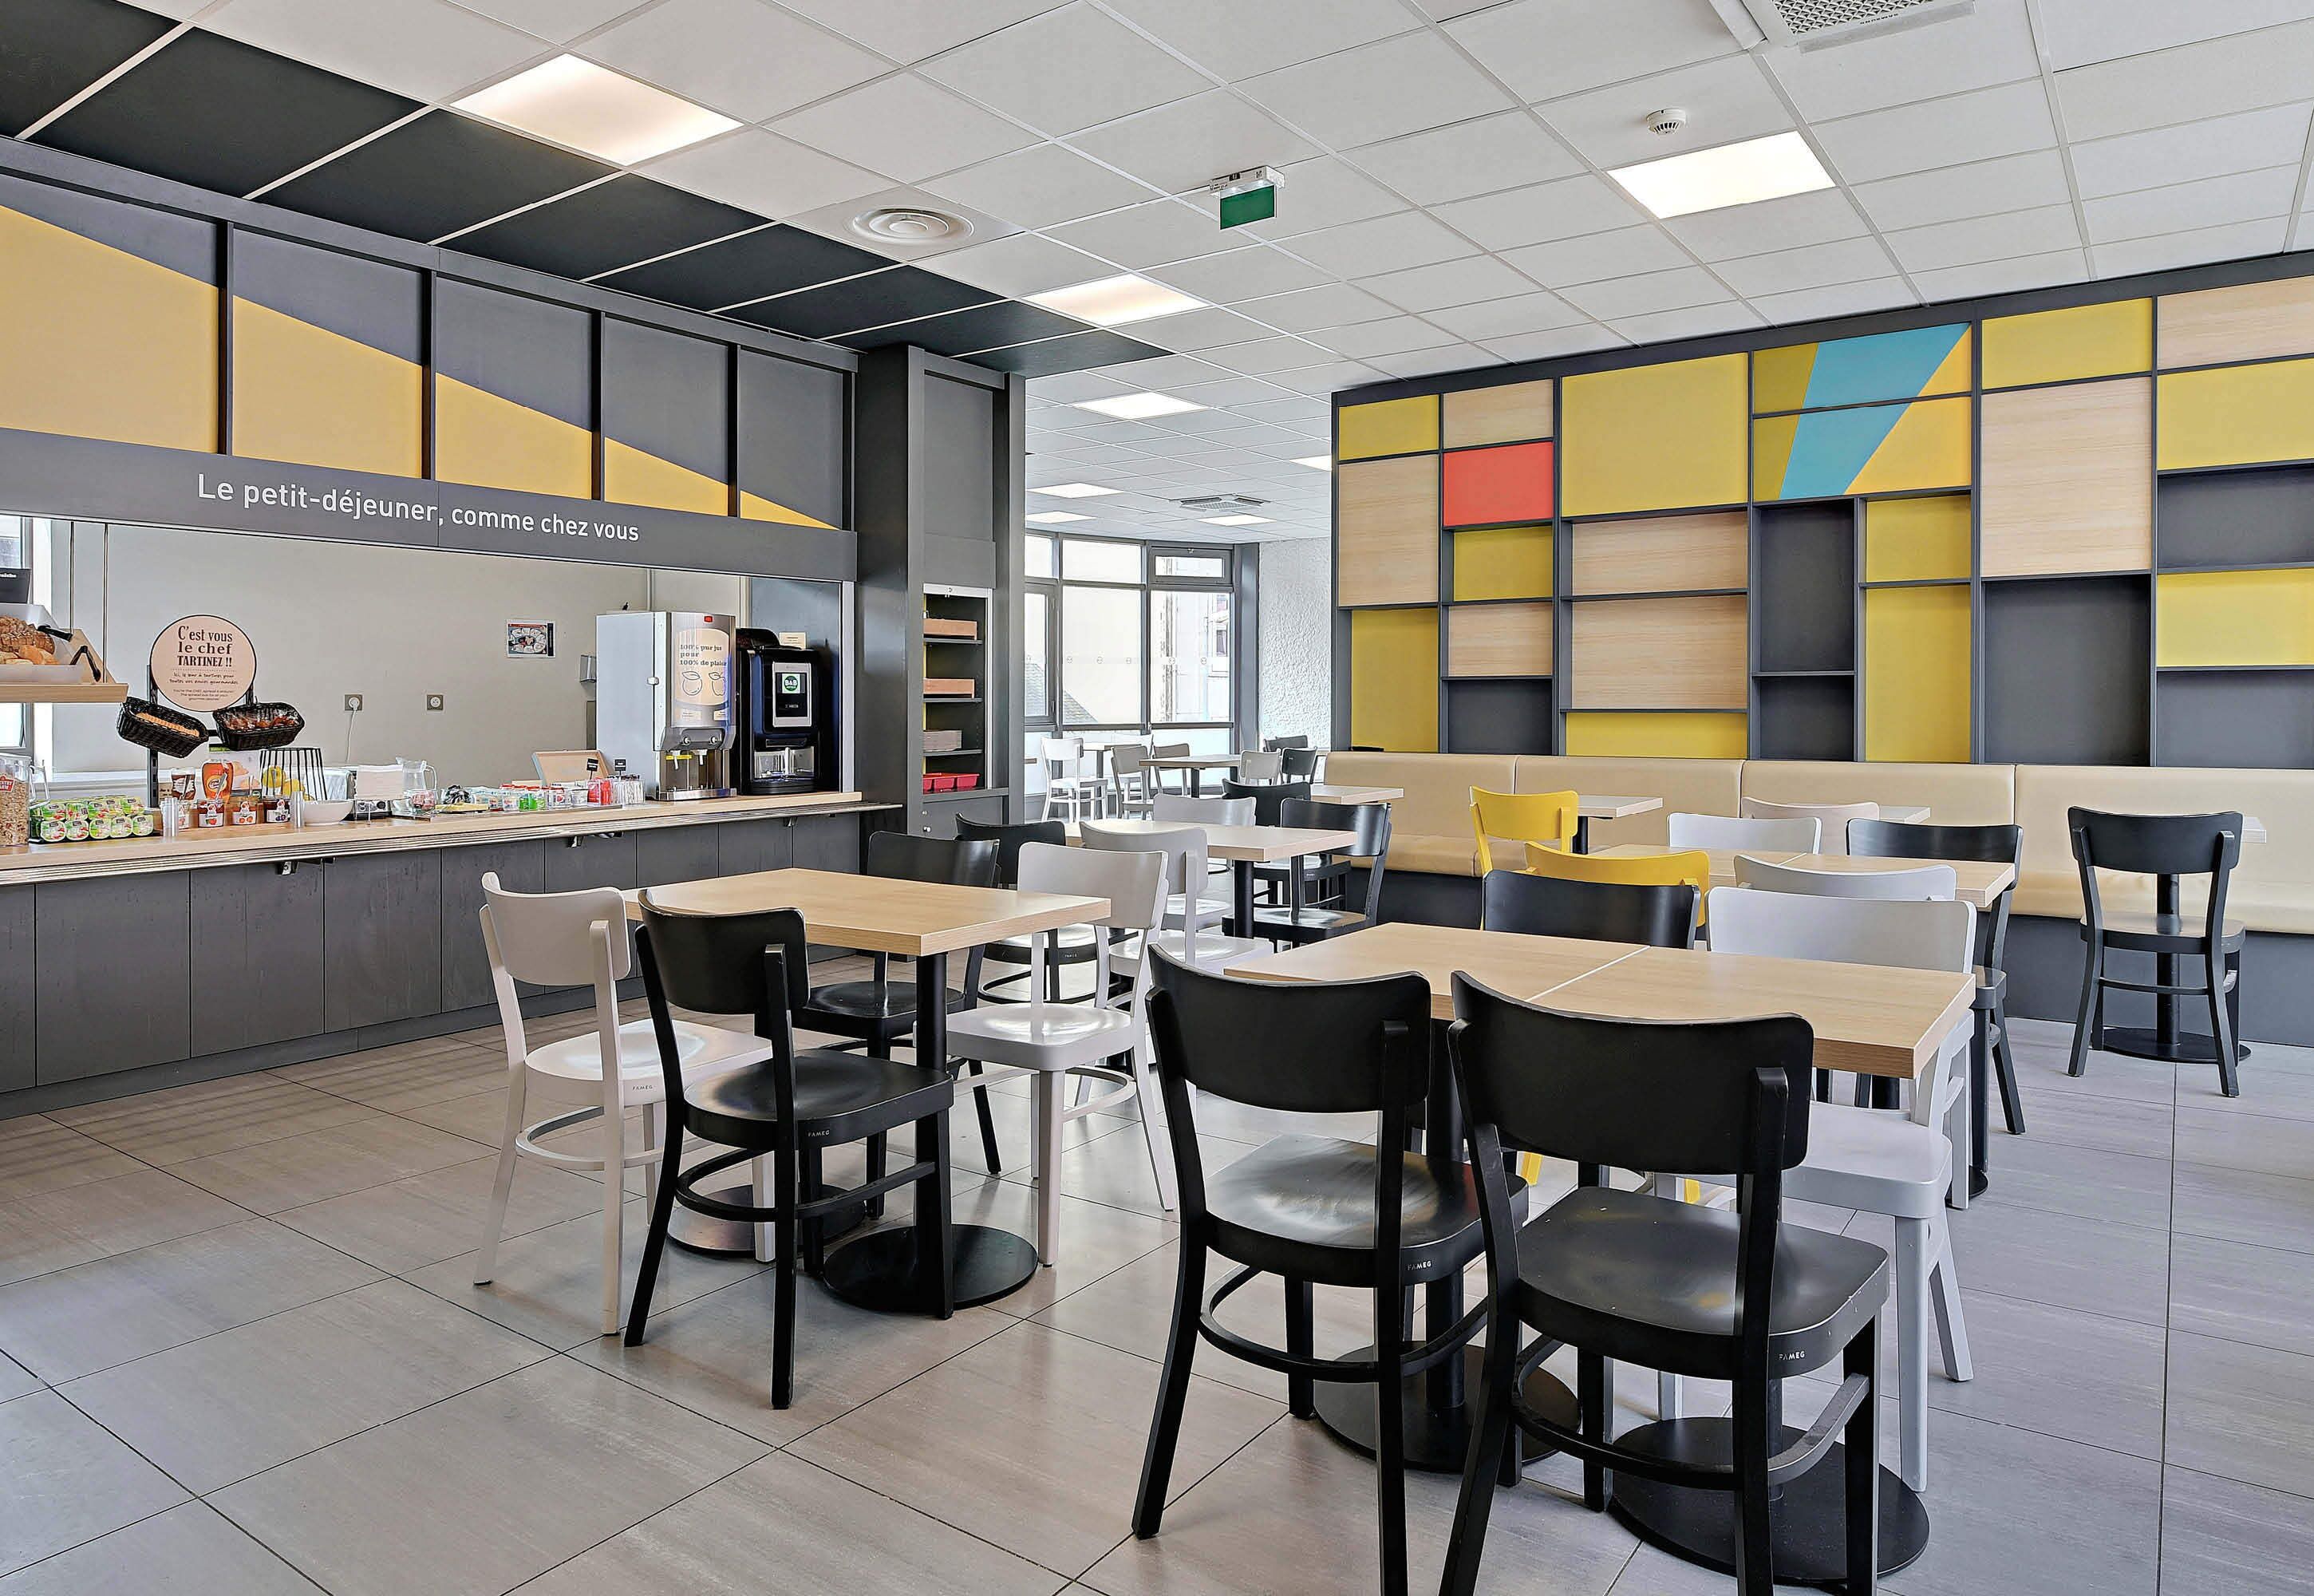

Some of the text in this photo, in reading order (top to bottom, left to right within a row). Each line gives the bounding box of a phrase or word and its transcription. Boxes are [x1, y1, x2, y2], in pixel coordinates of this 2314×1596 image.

[199, 473, 639, 541] Le petit-déjeuner, comme chez vous
[178, 625, 233, 642] C'est vous
[178, 641, 232, 654] le chef
[177, 655, 223, 667] TARTINEZ
[1407, 1261, 1432, 1270] FAMEG
[1779, 1351, 1805, 1361] FAMEG
